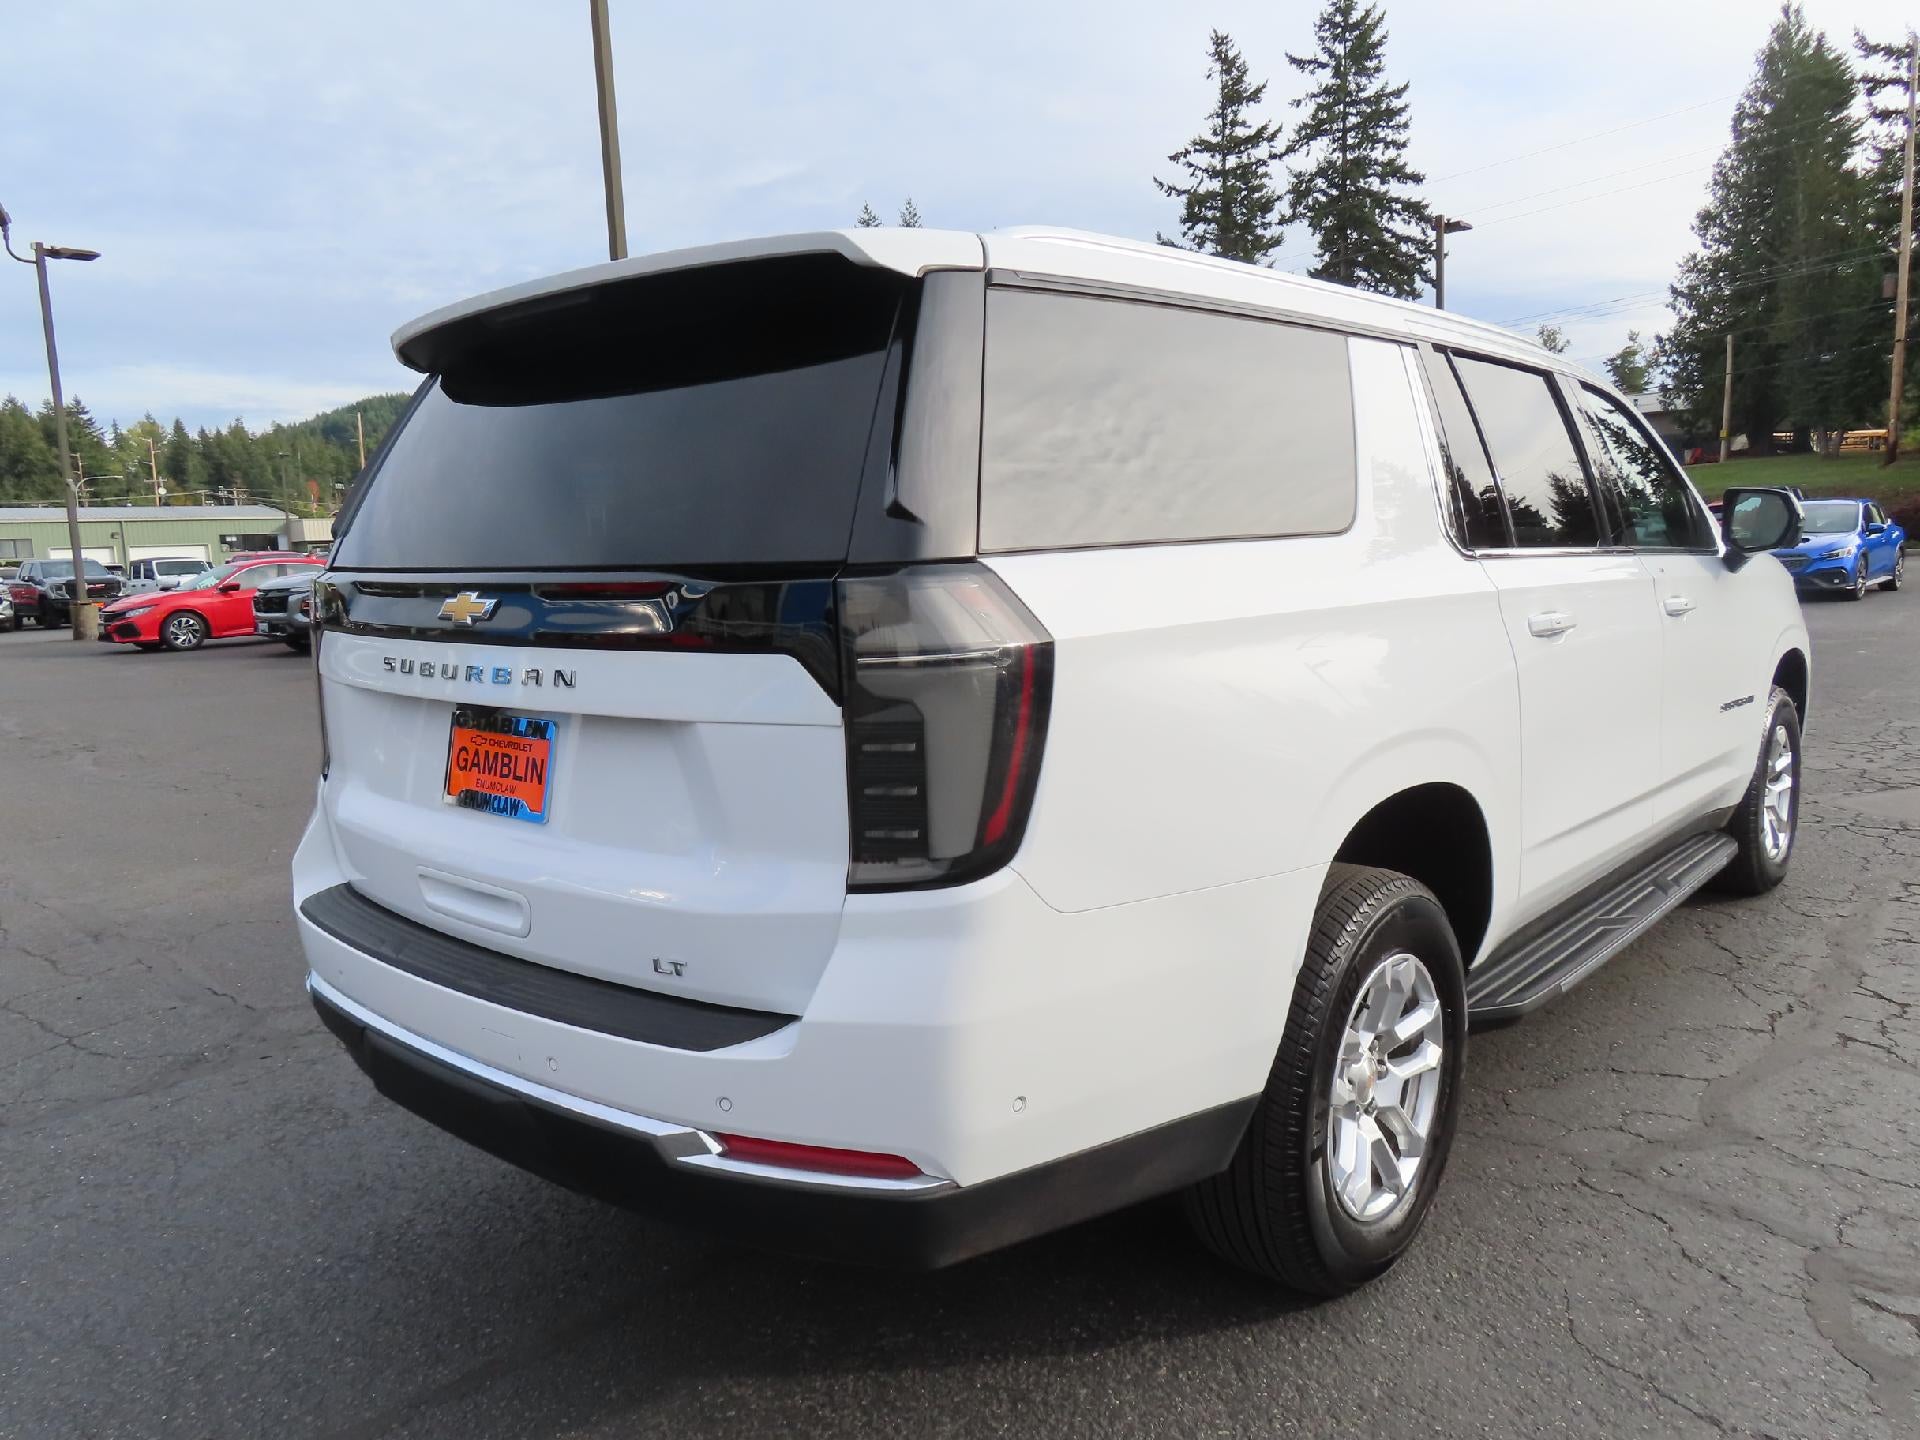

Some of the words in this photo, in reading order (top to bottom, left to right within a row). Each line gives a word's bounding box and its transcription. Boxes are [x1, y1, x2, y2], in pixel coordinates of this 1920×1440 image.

[383, 657, 577, 687] SUBURBAN
[488, 738, 533, 753] CHEVROLET
[456, 745, 545, 785] GAMBLIN
[652, 958, 687, 977] LT
